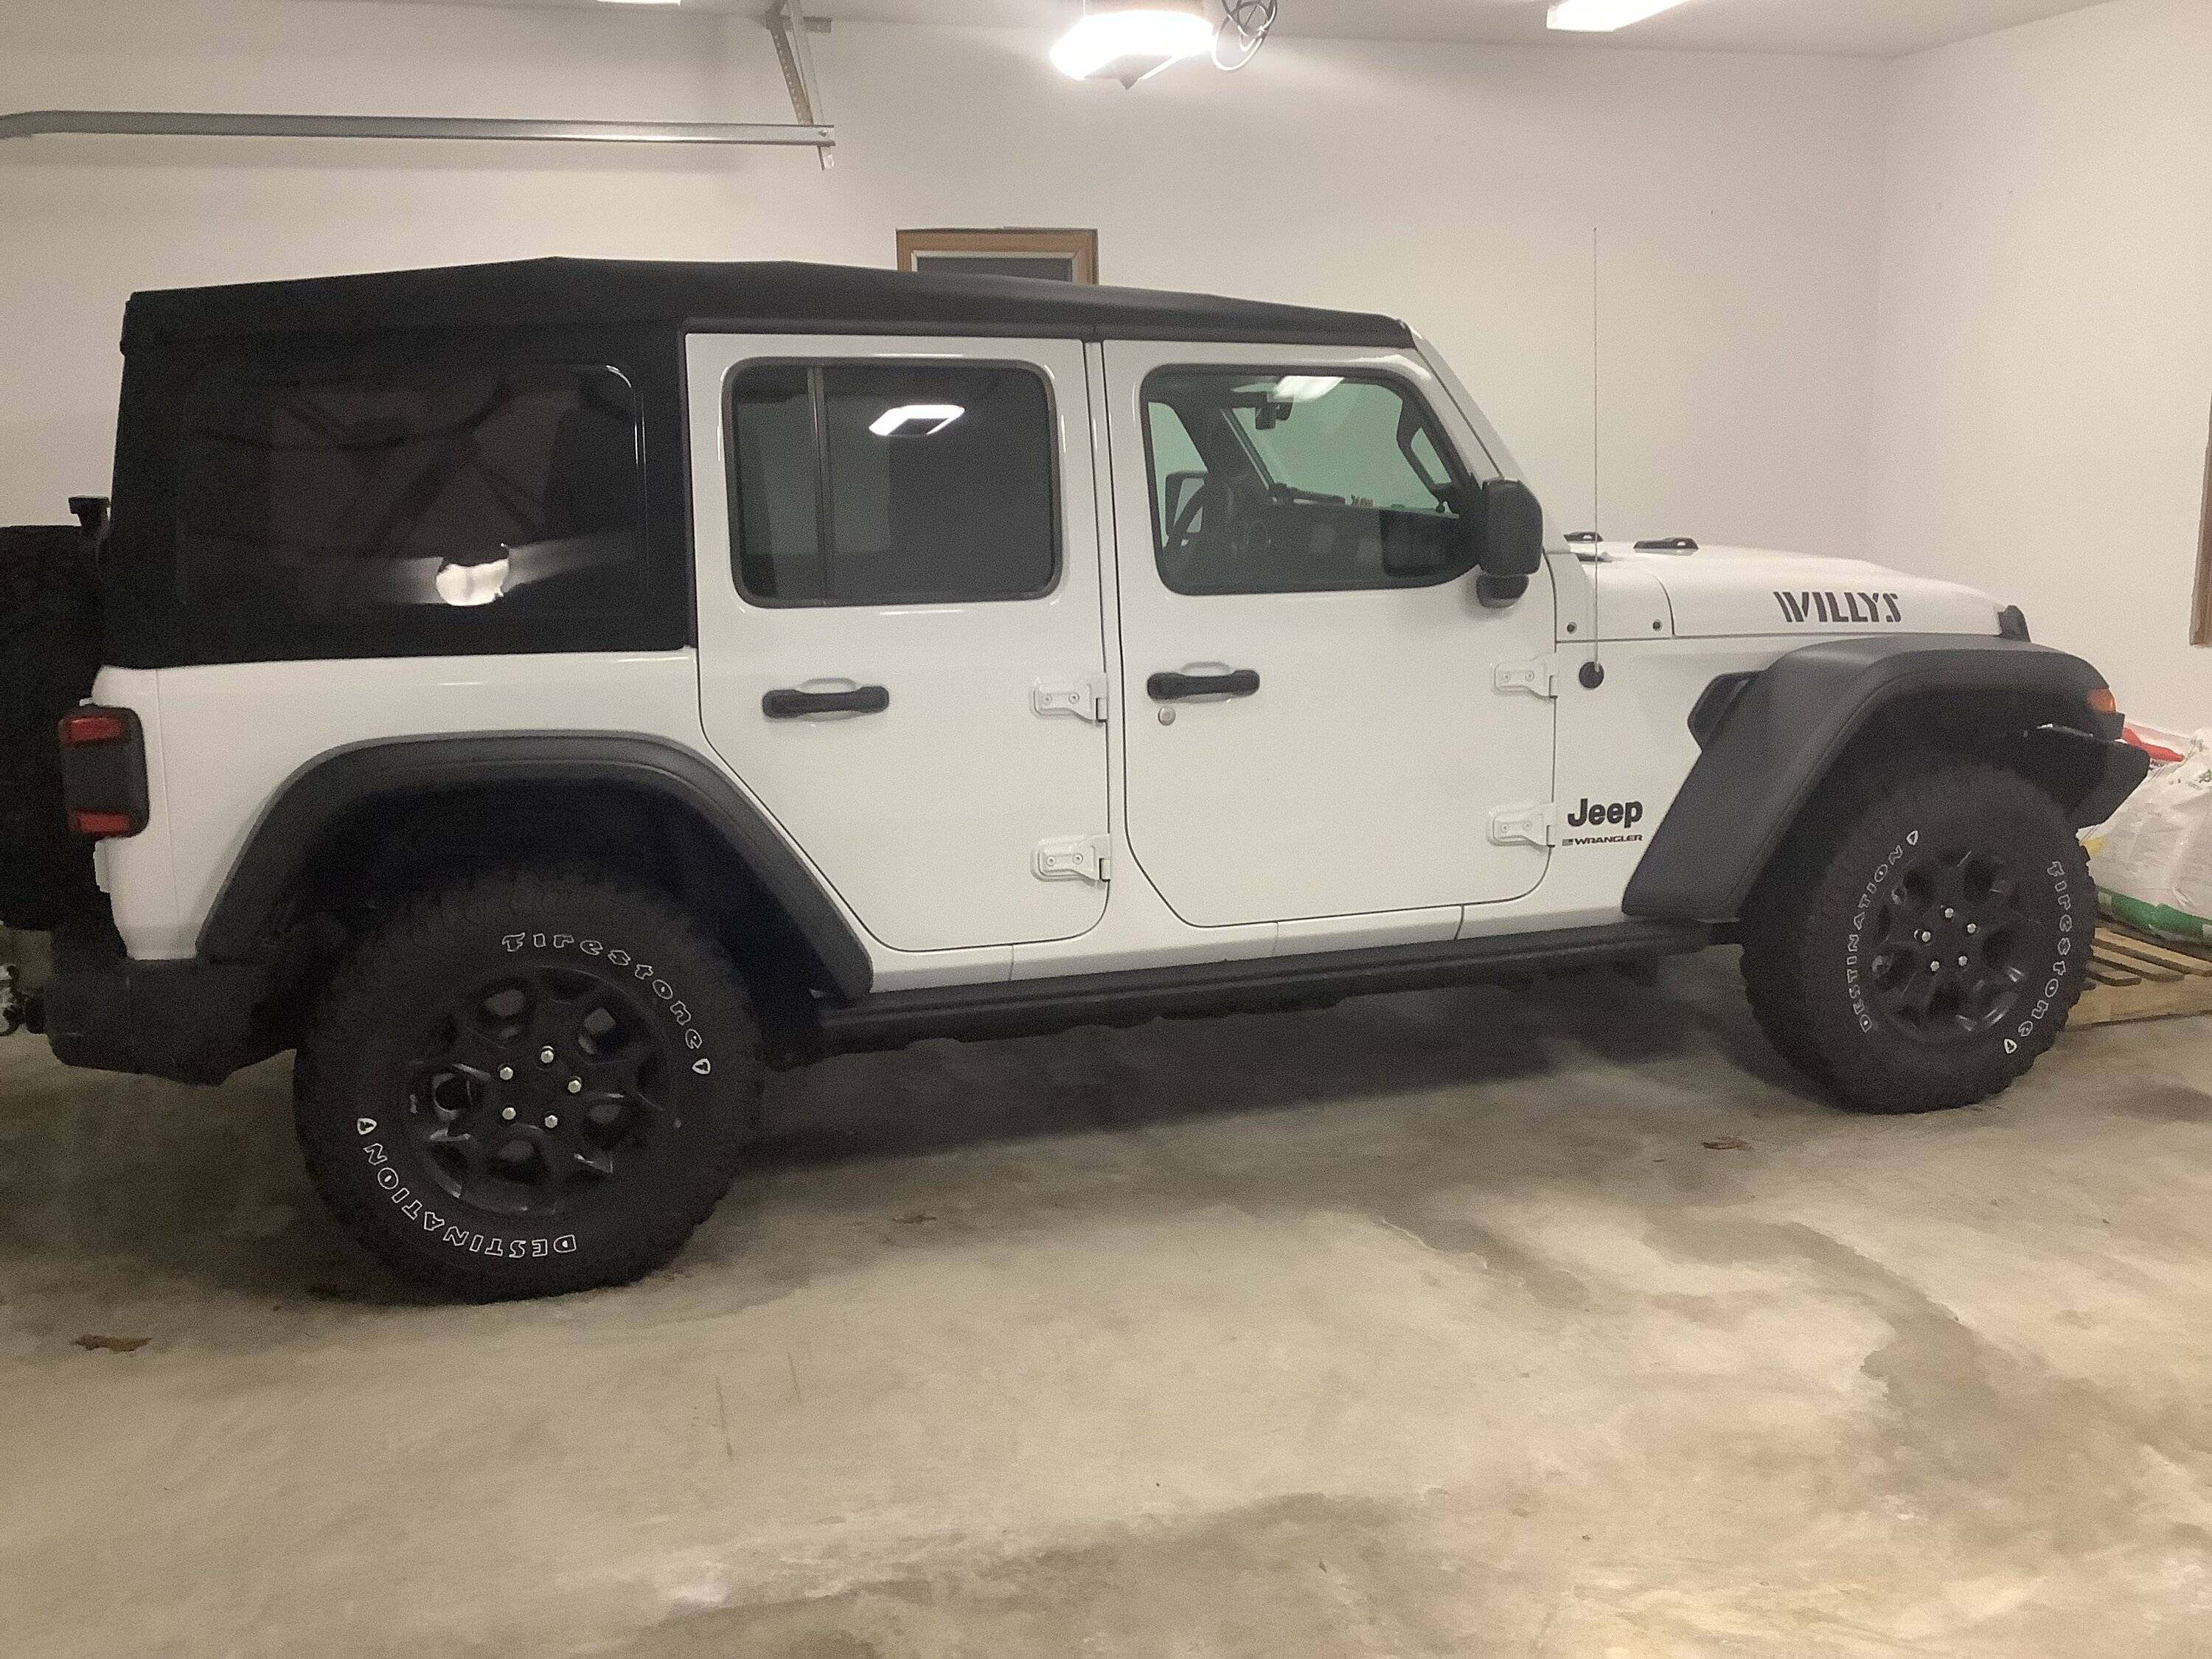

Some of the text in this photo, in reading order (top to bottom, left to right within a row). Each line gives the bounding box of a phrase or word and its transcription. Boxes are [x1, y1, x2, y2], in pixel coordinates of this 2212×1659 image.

[1773, 591, 1902, 622] WILLYS
[1568, 798, 1643, 828] Jeep
[1574, 834, 1643, 845] WRANGLER
[502, 932, 702, 1049] Firestone
[1847, 845, 1903, 1033] DESTINATION
[2018, 861, 2073, 1037] Firestone
[364, 1143, 577, 1259] DESTINATION
